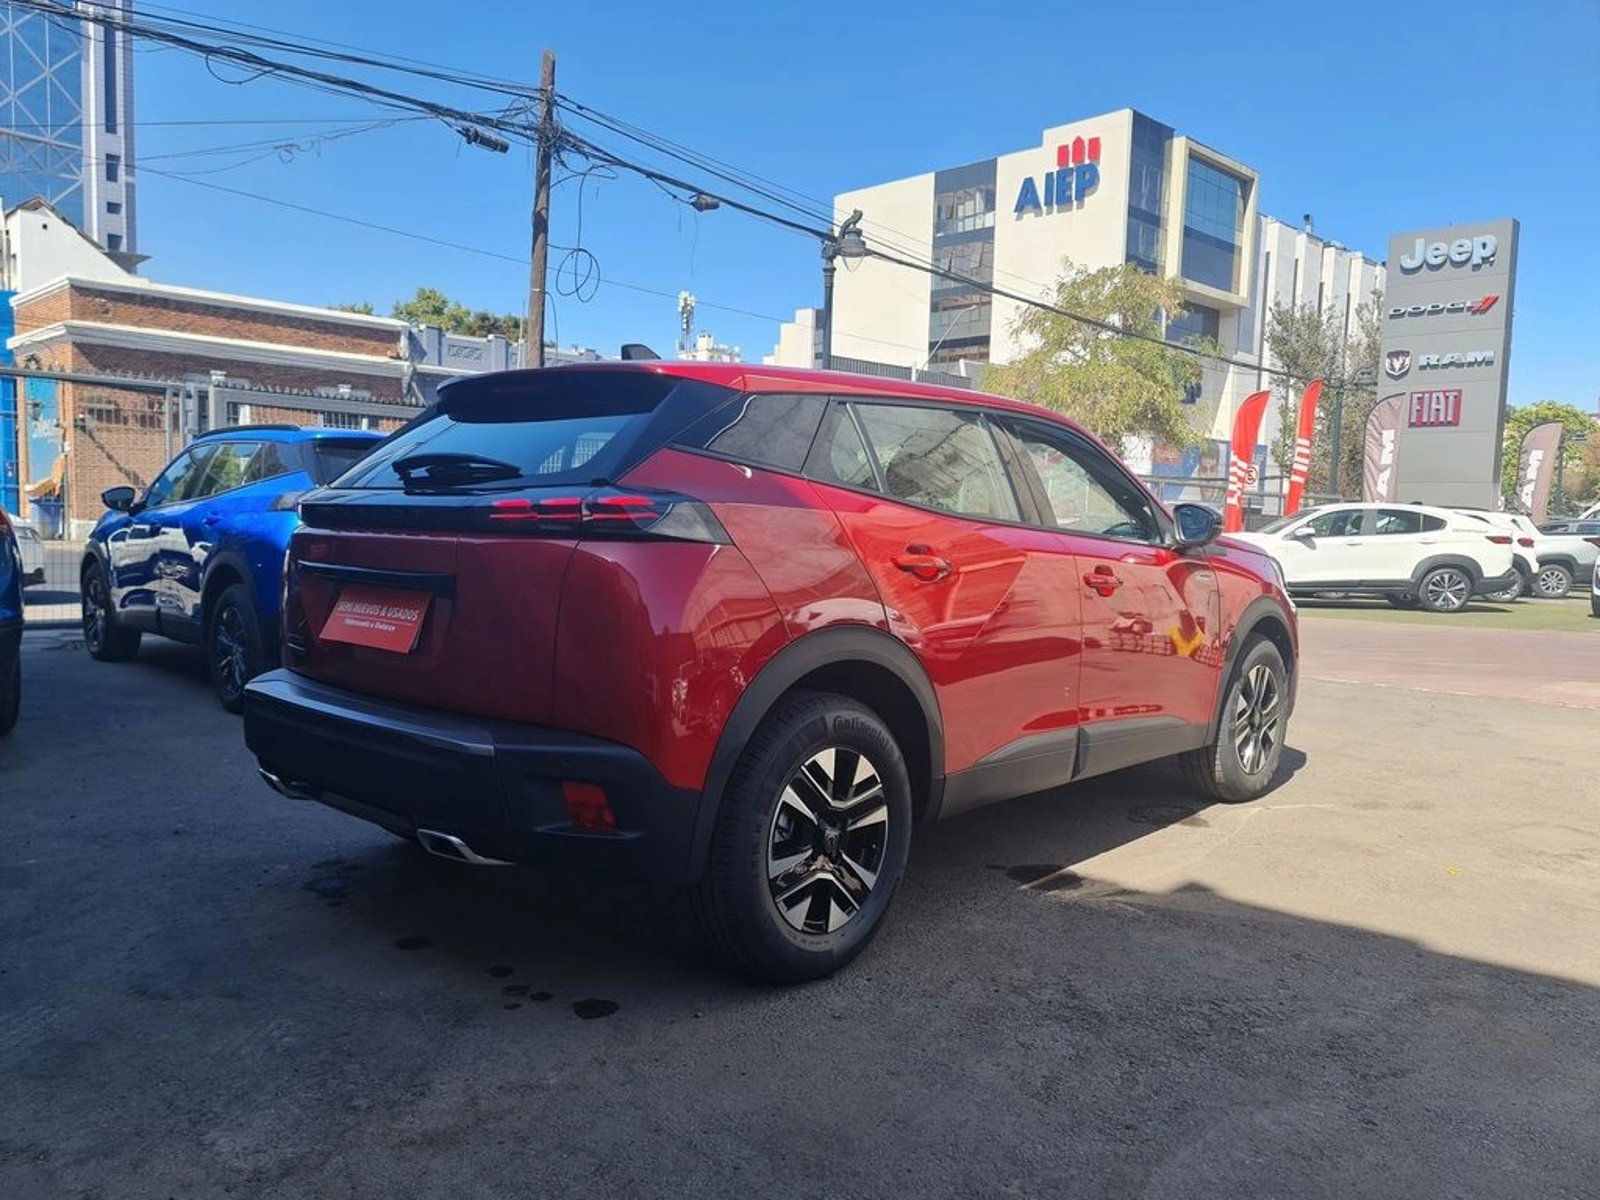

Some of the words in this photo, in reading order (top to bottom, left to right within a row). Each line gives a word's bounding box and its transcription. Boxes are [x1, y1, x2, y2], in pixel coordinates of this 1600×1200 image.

[1013, 163, 1101, 215] AIEP
[1400, 235, 1498, 273] Jeep
[1418, 350, 1495, 371] RAM
[1410, 391, 1460, 425] FIAT
